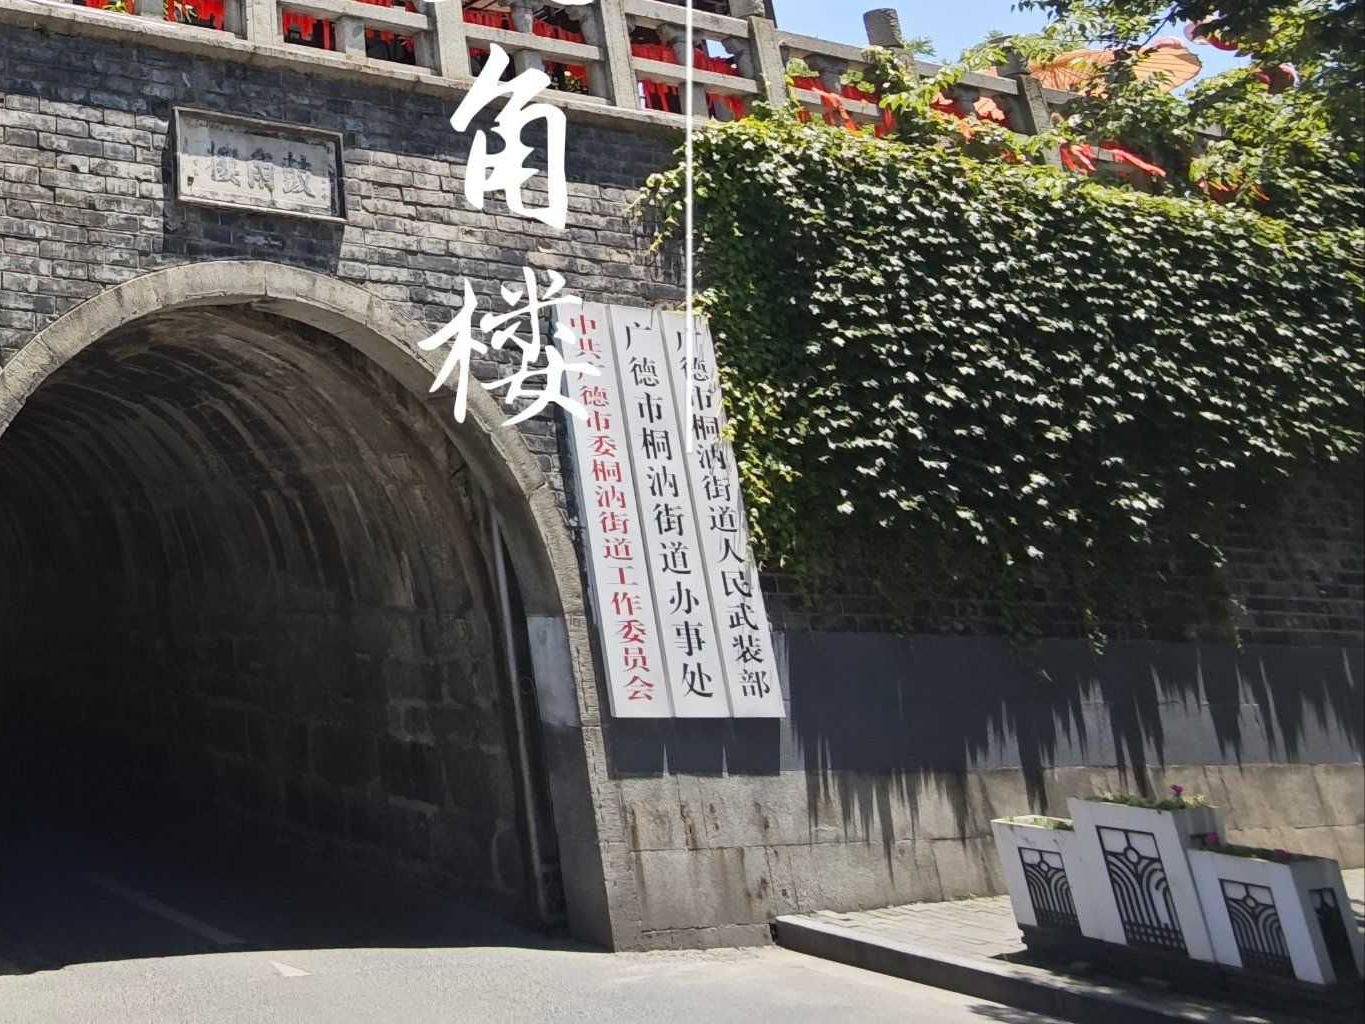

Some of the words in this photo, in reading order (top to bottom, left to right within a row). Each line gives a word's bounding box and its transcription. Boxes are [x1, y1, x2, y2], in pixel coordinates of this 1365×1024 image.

[624, 321, 714, 699] 广德市桐汭街道办事处
